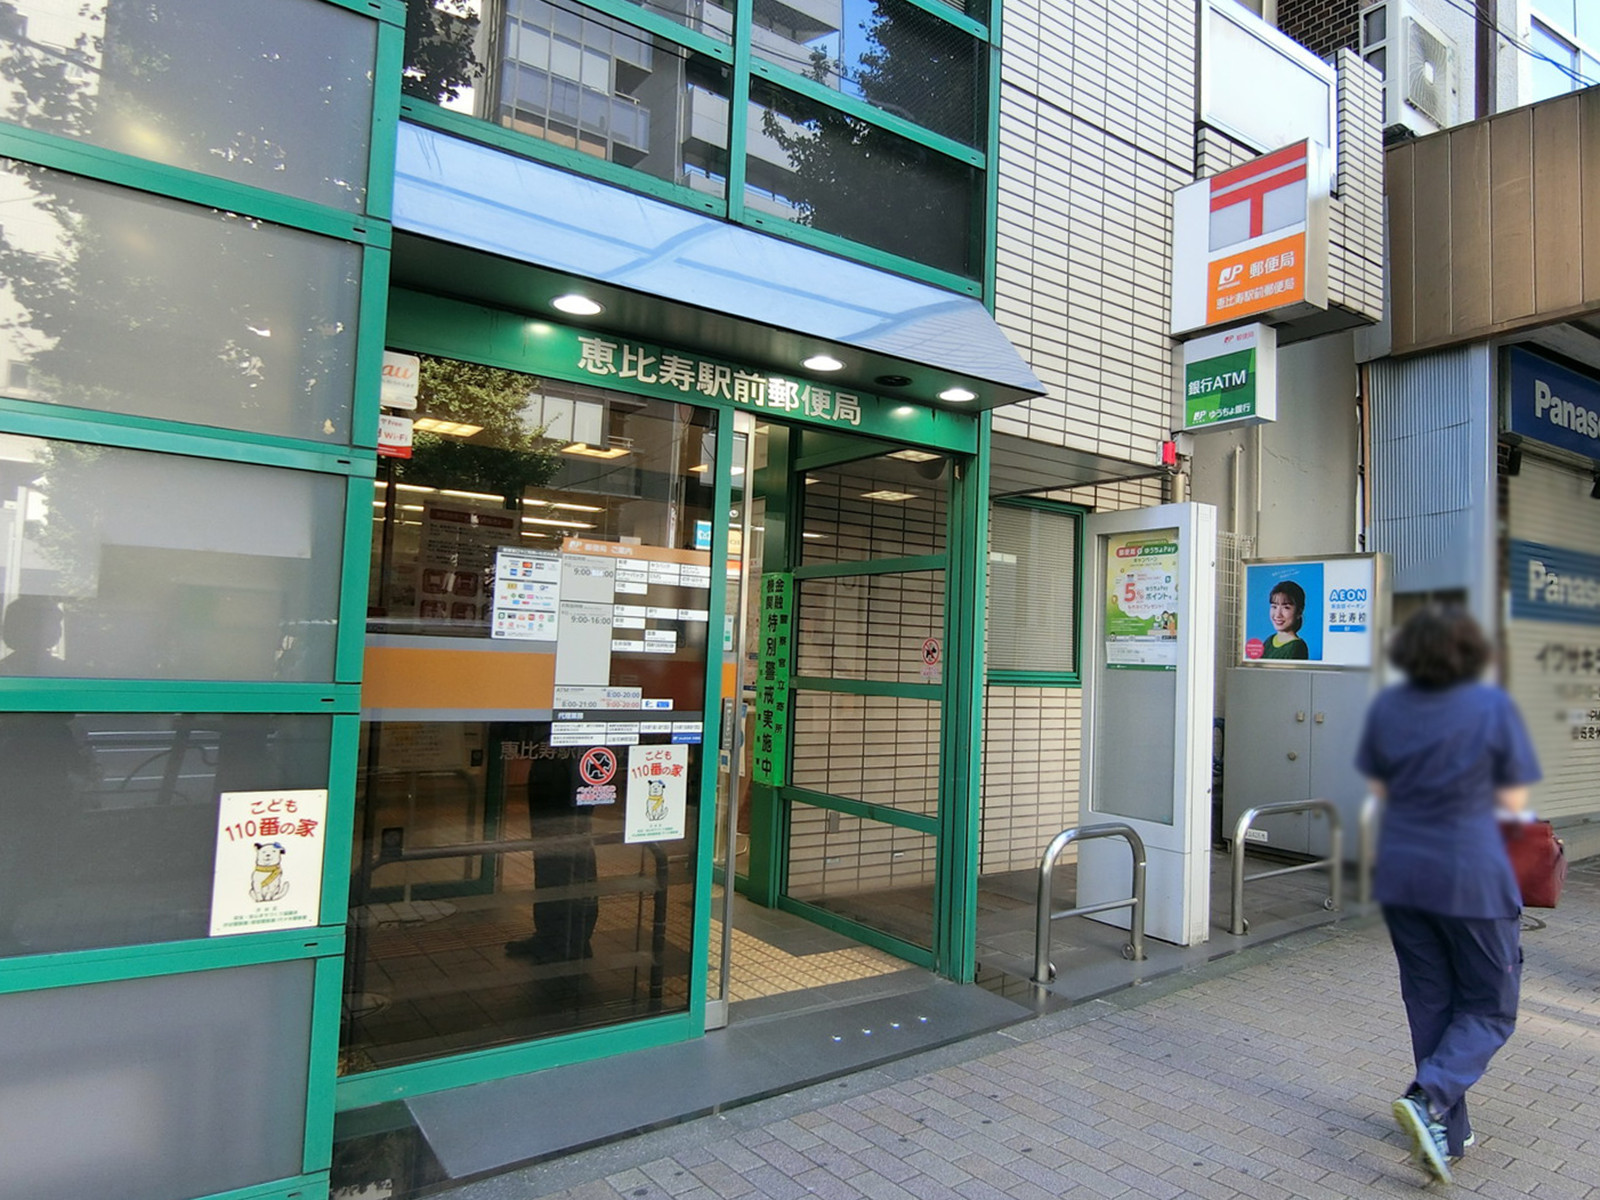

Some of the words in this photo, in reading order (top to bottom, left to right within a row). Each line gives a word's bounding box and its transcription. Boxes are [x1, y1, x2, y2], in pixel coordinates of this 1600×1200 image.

[1249, 251, 1295, 279] 郵便局
[1216, 277, 1296, 310] 恵比寿駅前郵便局
[382, 364, 414, 379] au
[577, 335, 863, 427] 恵比寿駅前郵便局
[1187, 369, 1247, 395] 銀行ATM
[1208, 403, 1252, 419] ゆうちょ銀行
[1535, 379, 1600, 440] Panas
[387, 419, 404, 427] Free
[383, 430, 409, 442] Wi-Fi
[573, 567, 614, 578] 9:00-:00
[1528, 559, 1600, 609] Panas
[1329, 588, 1367, 602] AEON
[570, 616, 611, 625] 9:00-16:00
[1328, 612, 1367, 623] 恵比寿校
[761, 613, 779, 777] 特別警戒実施中
[645, 750, 672, 761] こども
[631, 762, 684, 780] 110番の家
[251, 798, 298, 815] こども
[225, 816, 319, 842] 110番の家
